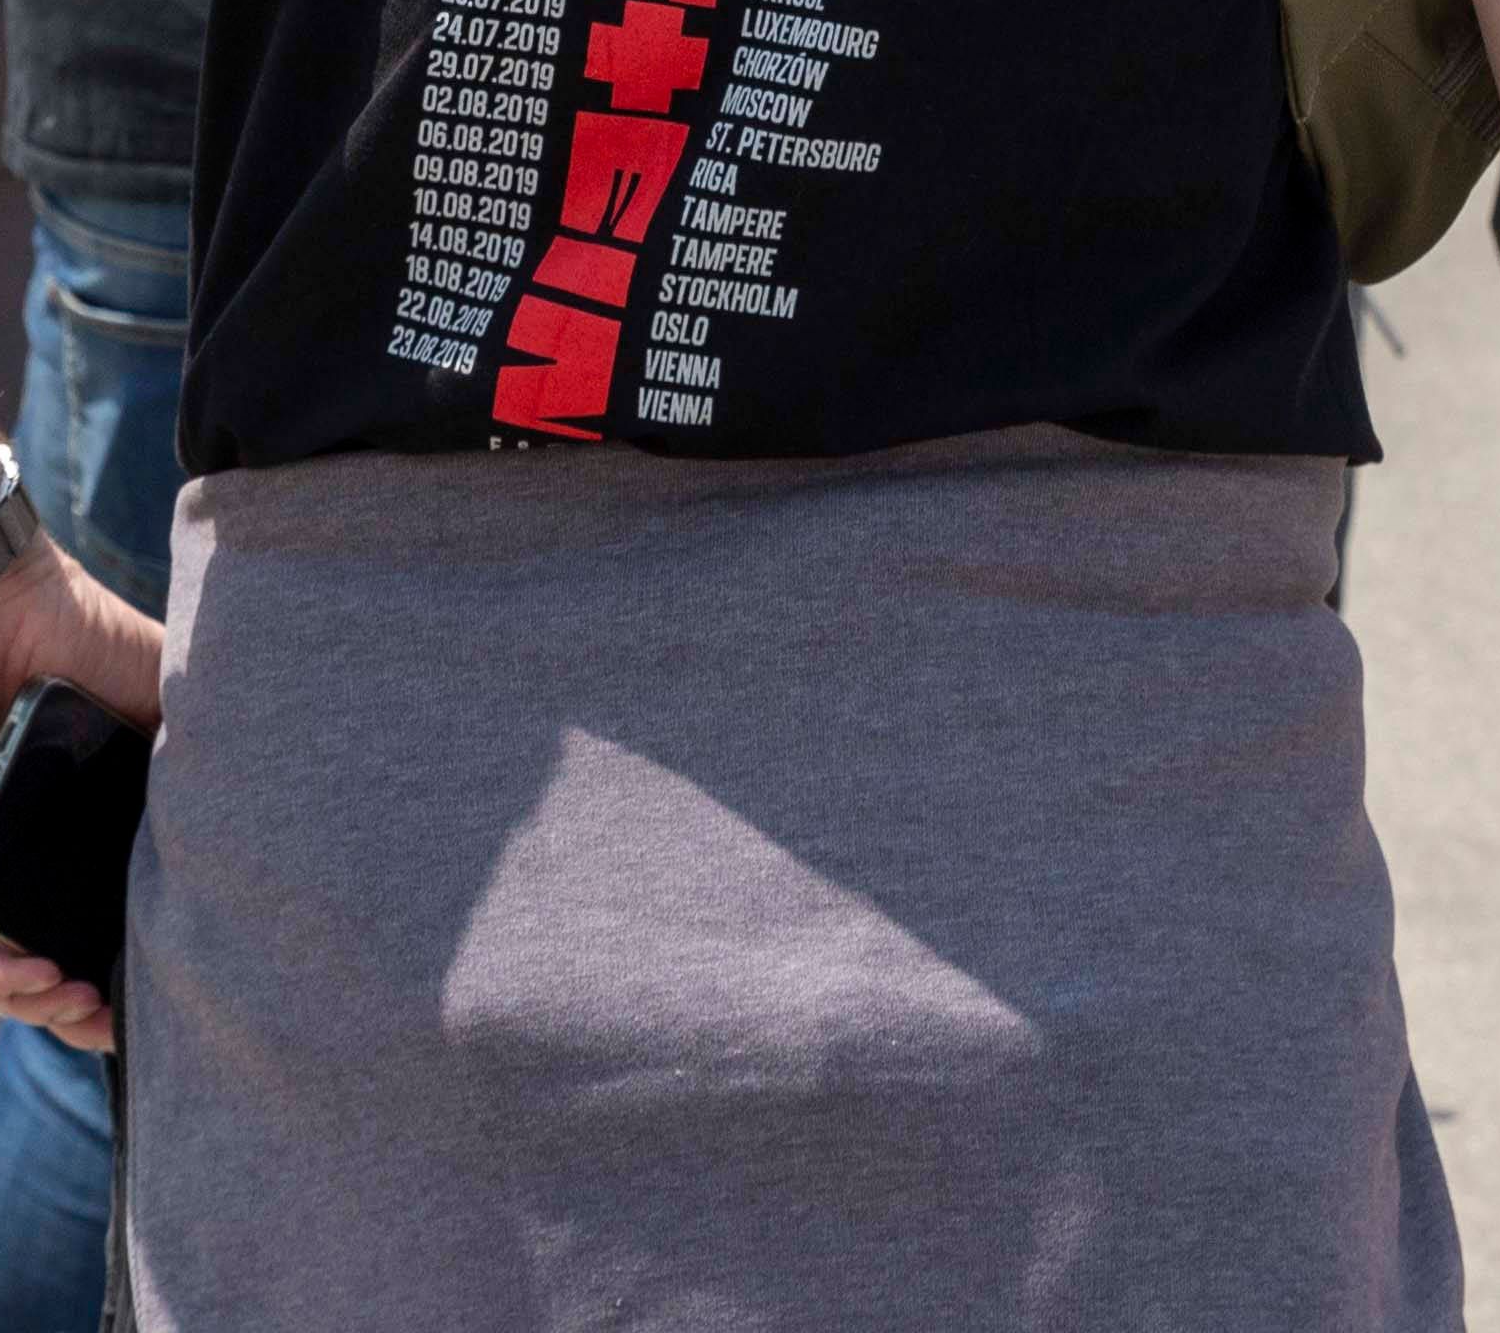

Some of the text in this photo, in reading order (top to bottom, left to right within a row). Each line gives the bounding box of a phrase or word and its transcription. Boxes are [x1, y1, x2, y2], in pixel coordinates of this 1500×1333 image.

[431, 11, 561, 56] 24.07.2019
[740, 8, 880, 59] LUXEMBOURG
[425, 49, 555, 91] 29.07.2019
[731, 45, 830, 92] CHORZÓW
[421, 84, 549, 126] 02.08.2019
[718, 83, 814, 128] MOSCOW
[416, 119, 544, 161] 06.08.2019
[705, 120, 882, 173] ST. PETERSBURG
[412, 154, 539, 196] 09.08.2019
[688, 157, 738, 196] RIGA
[412, 187, 531, 231] 10.08.2019
[679, 194, 787, 240] TAMPERE
[408, 221, 526, 268] 14.08.2019
[669, 234, 778, 277] TAMPERE
[404, 254, 512, 302] 18.08.2019
[657, 272, 799, 319] STOCKHOLM
[396, 288, 494, 337] 22.08.2019
[649, 310, 709, 346] OSLO
[386, 324, 478, 375] 23.08.2019
[644, 348, 721, 389] VIENNA
[636, 386, 713, 426] VIENNA
